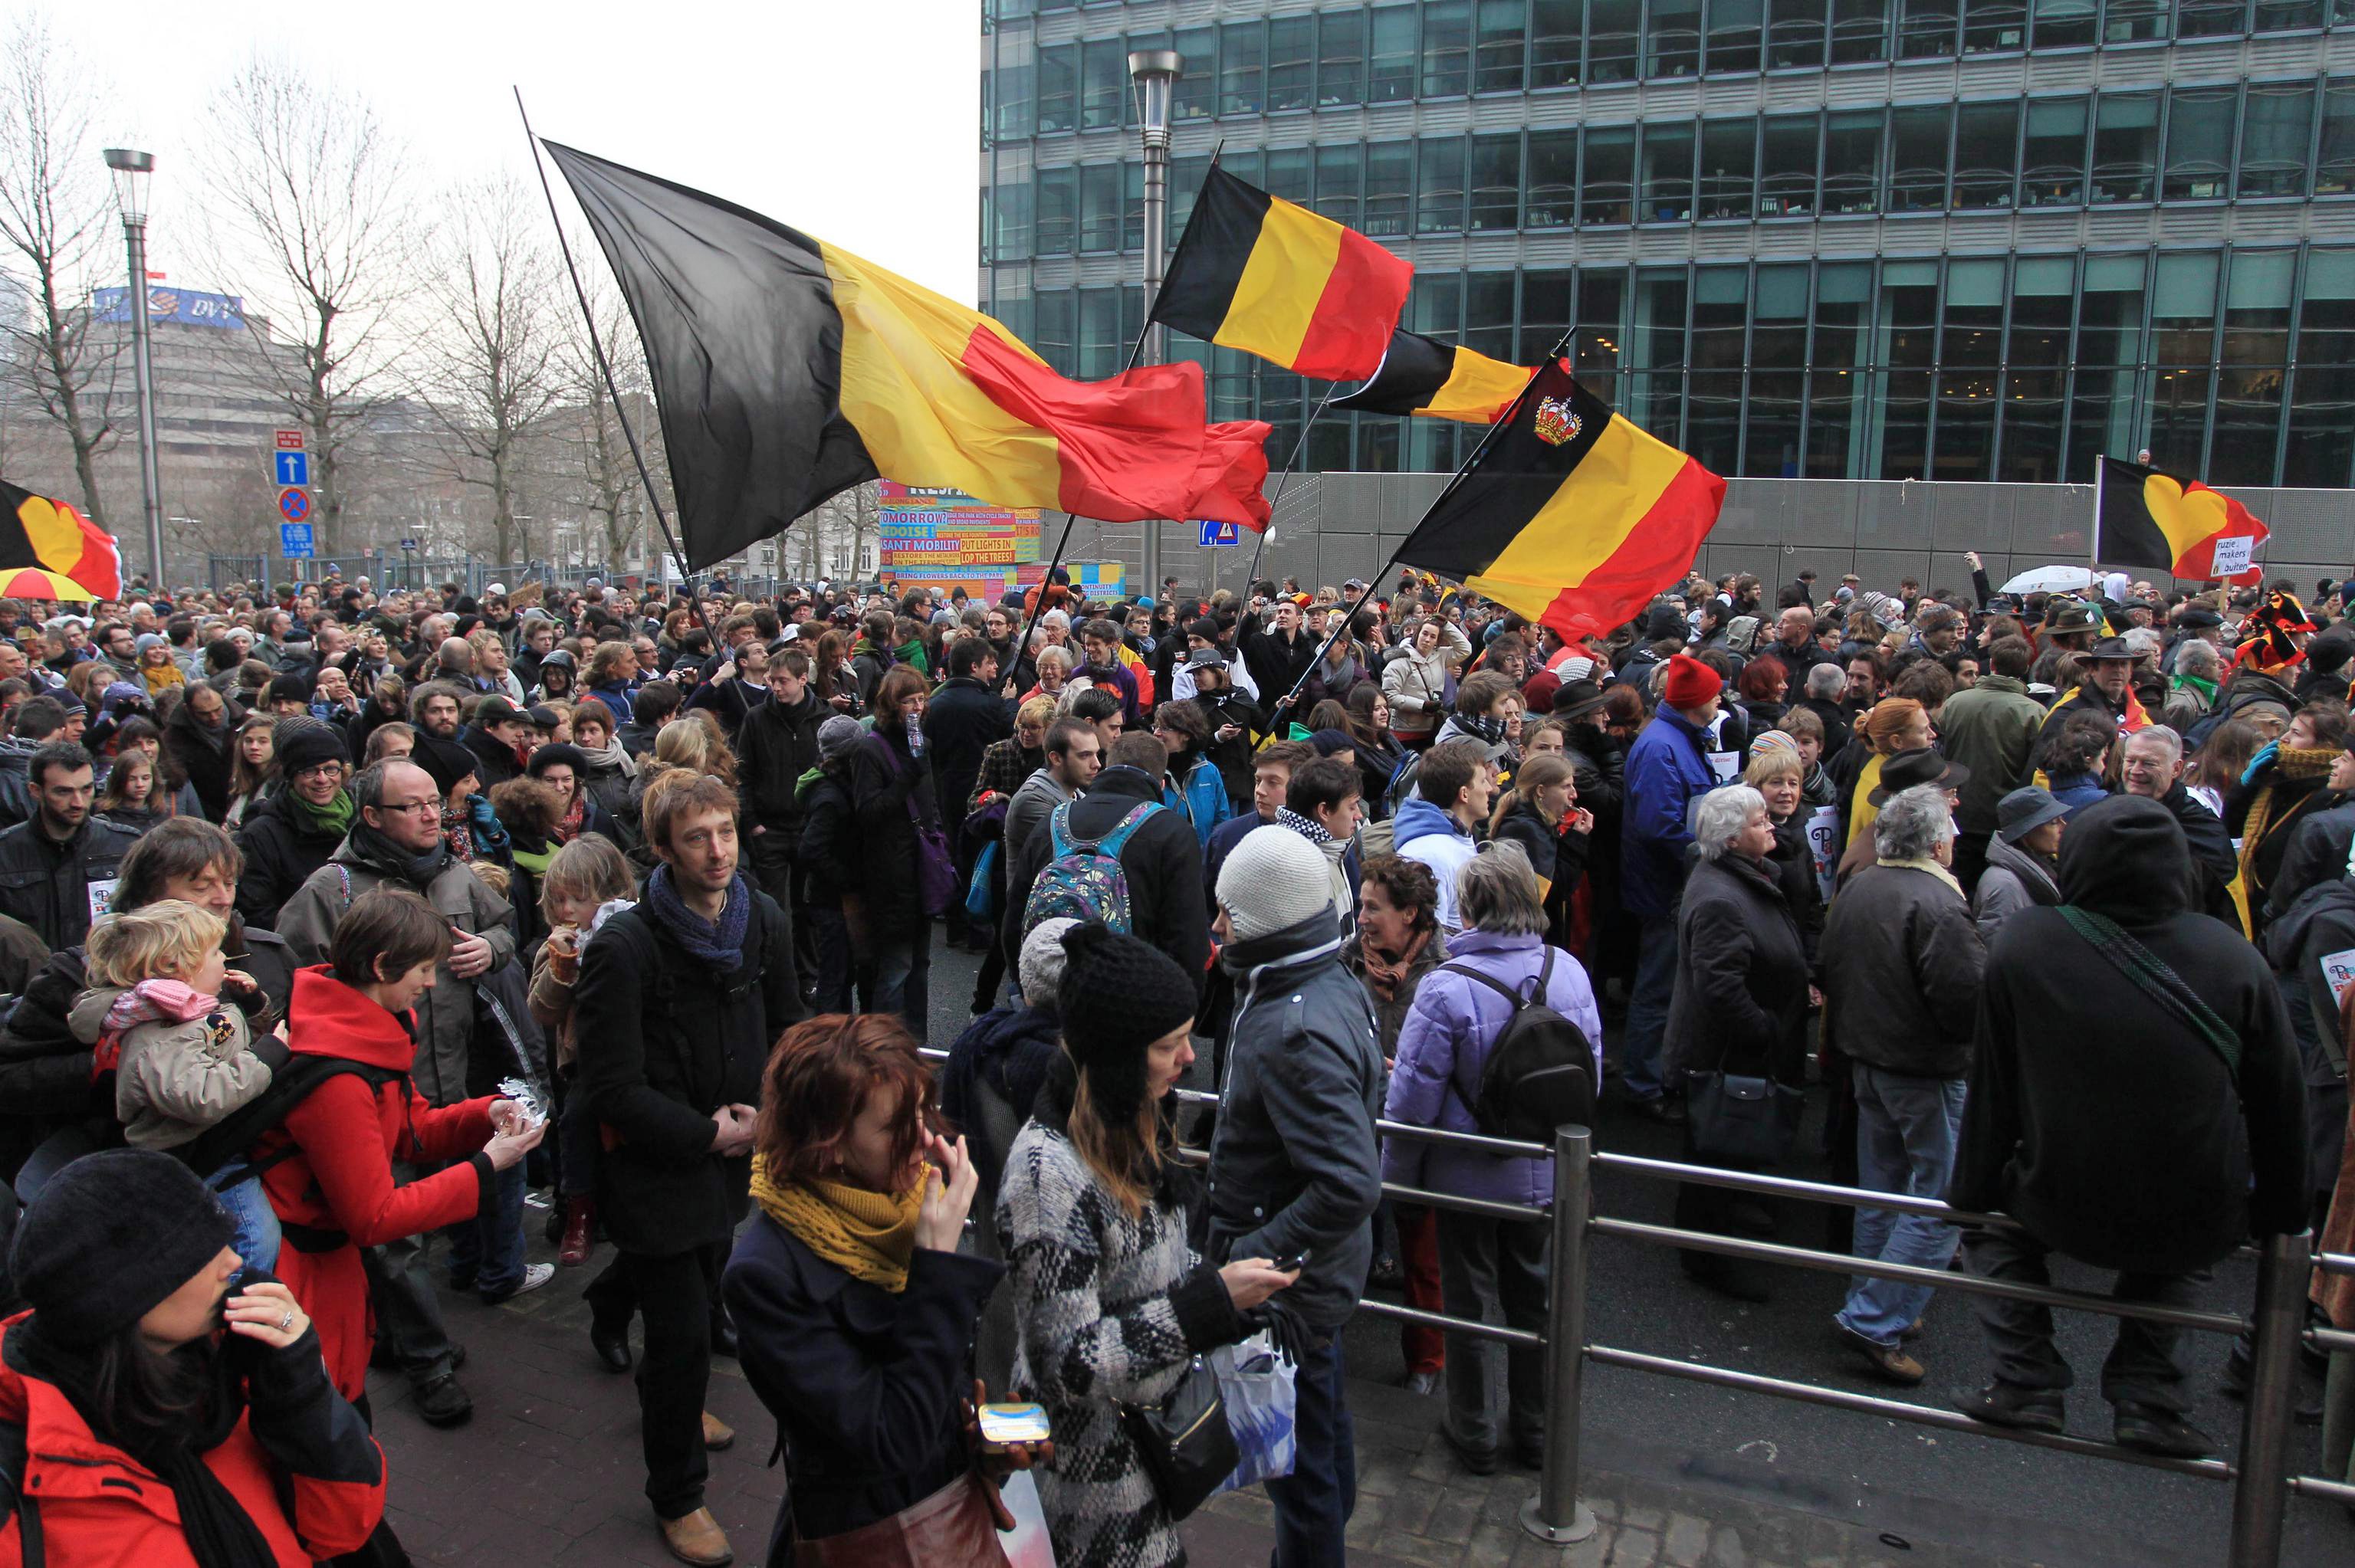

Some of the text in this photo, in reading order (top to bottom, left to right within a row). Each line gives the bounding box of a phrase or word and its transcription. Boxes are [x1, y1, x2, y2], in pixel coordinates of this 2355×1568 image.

[914, 540, 960, 550] MOBILITY
[961, 540, 1010, 550] PUT LIGHTS IN
[961, 553, 1012, 563] LOP THE TREES!
[2219, 549, 2245, 559] makers
[2225, 563, 2247, 572] buiten
